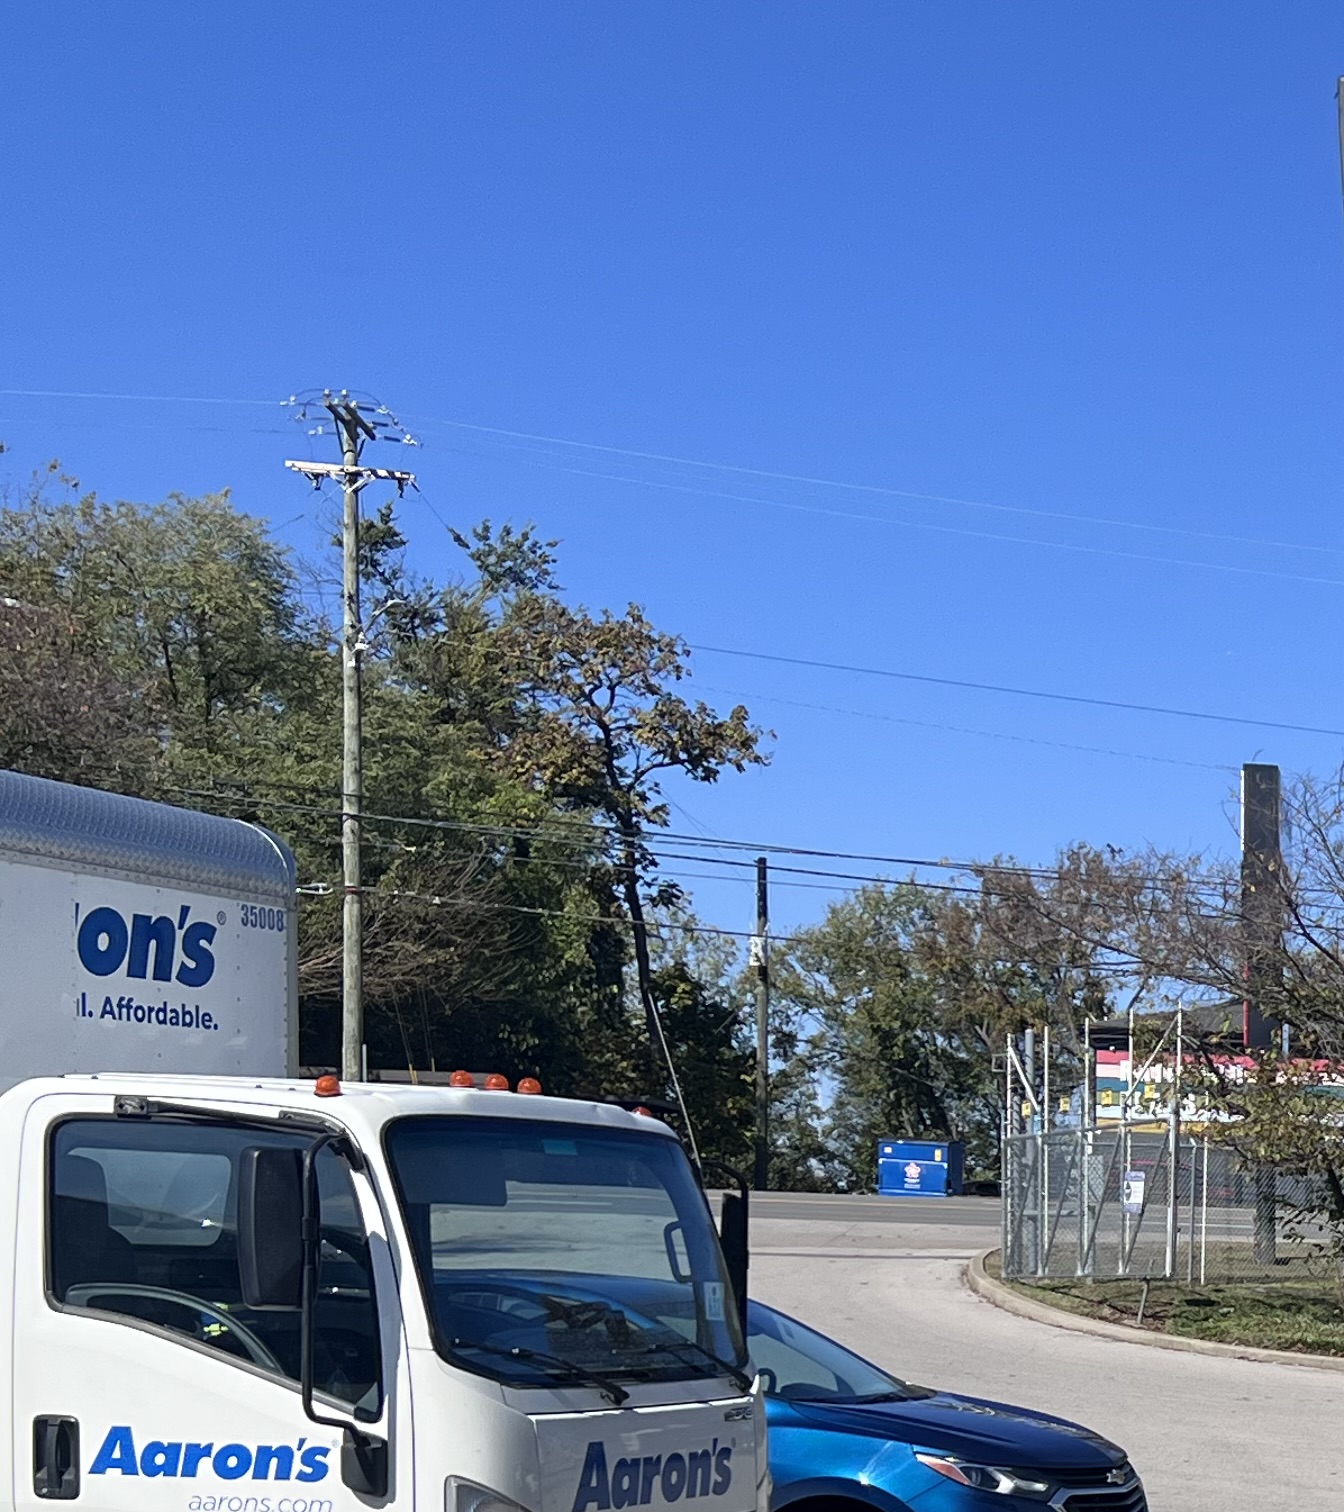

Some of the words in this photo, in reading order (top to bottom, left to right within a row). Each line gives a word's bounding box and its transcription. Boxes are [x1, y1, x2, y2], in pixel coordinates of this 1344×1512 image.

[241, 904, 285, 932] 35008
[75, 903, 217, 987] on's
[100, 996, 219, 1031] Affordable.
[88, 1426, 332, 1483] Aaron's
